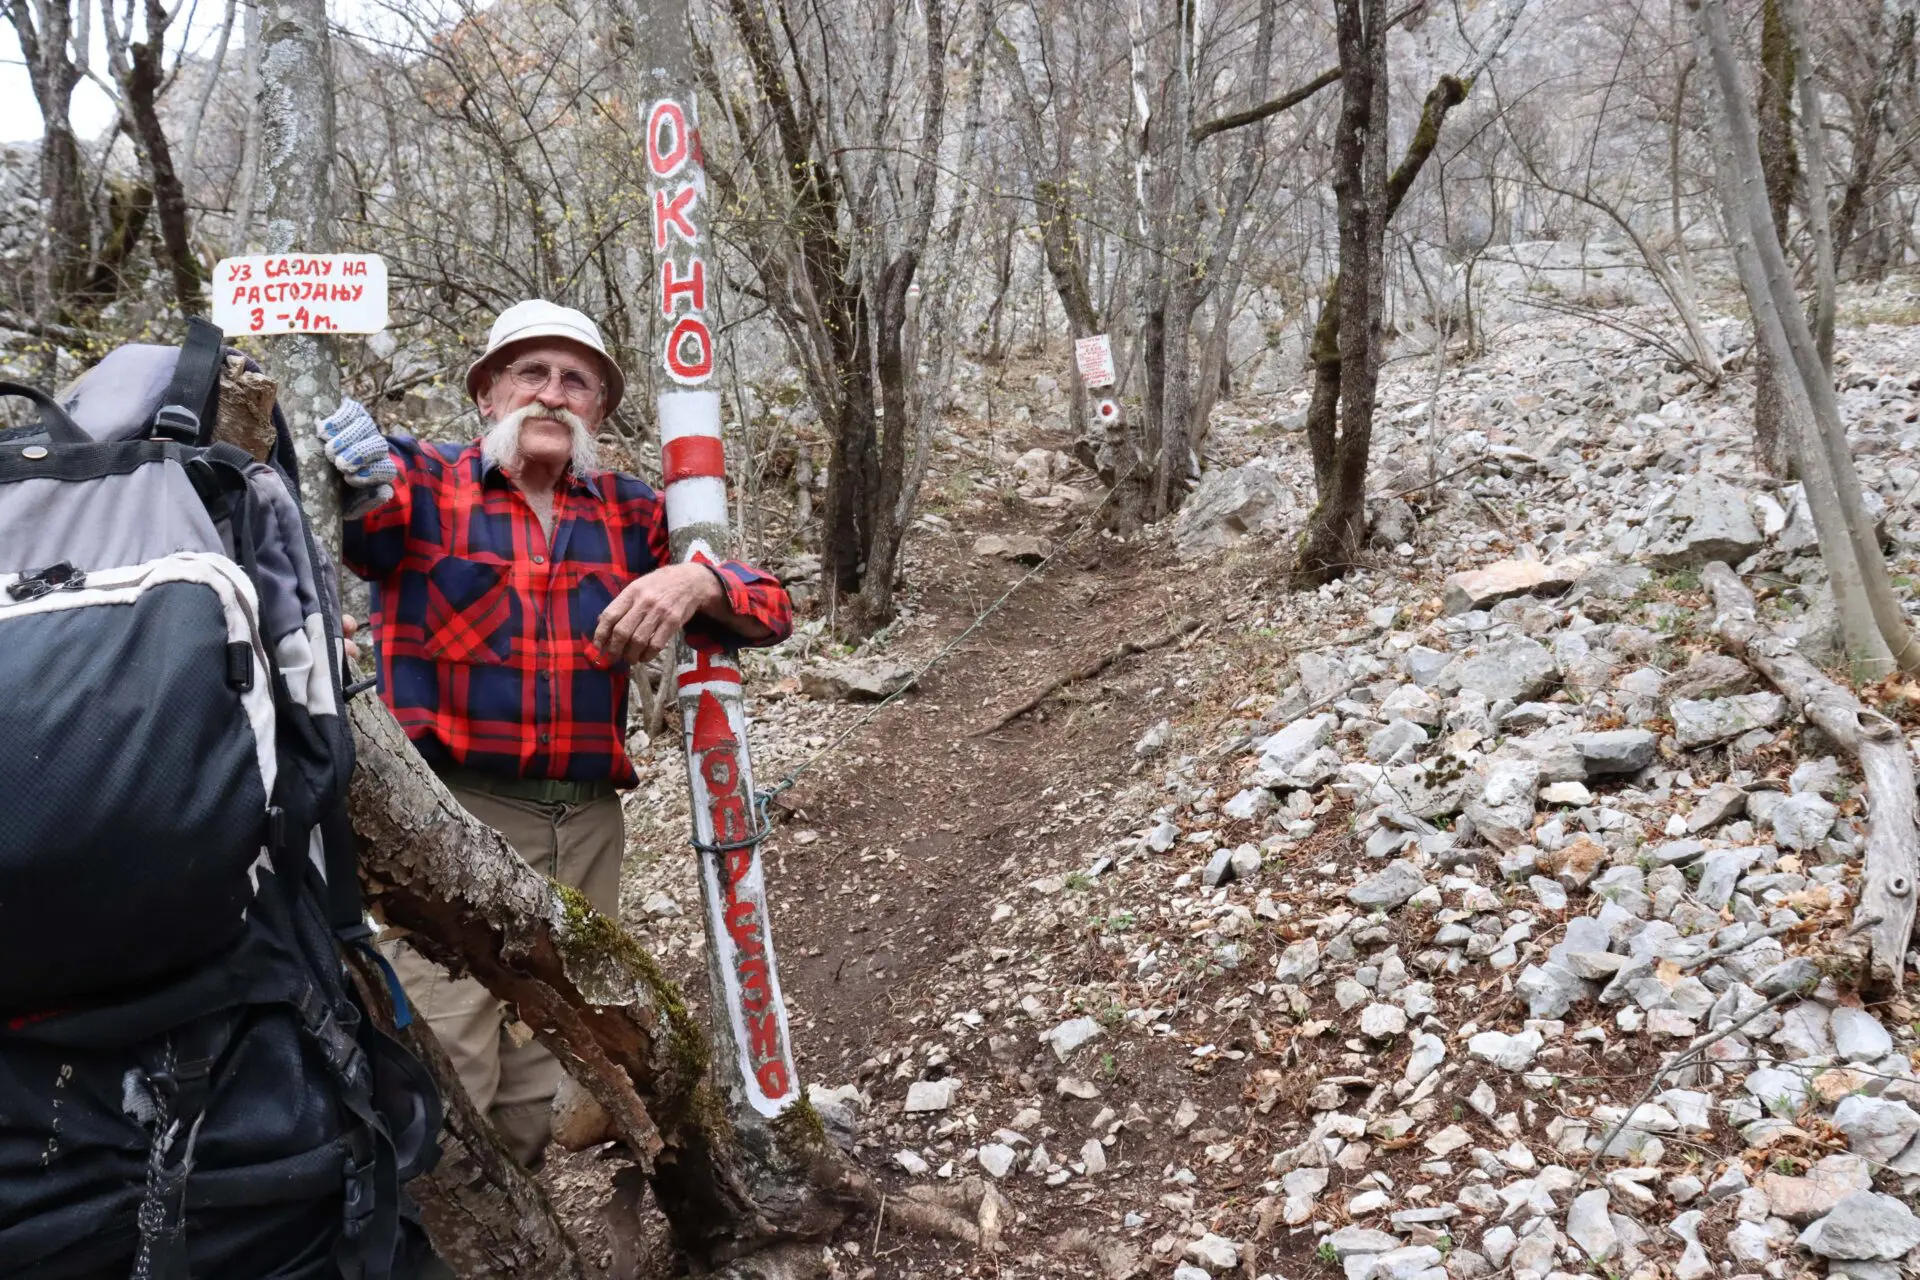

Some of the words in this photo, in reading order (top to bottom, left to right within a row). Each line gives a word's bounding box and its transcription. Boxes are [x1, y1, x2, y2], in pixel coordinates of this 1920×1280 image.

[649, 103, 713, 378] ОКНО
[228, 264, 252, 282] УЗ
[342, 261, 367, 276] НА
[232, 282, 363, 305] РАСТОЈАЊУ
